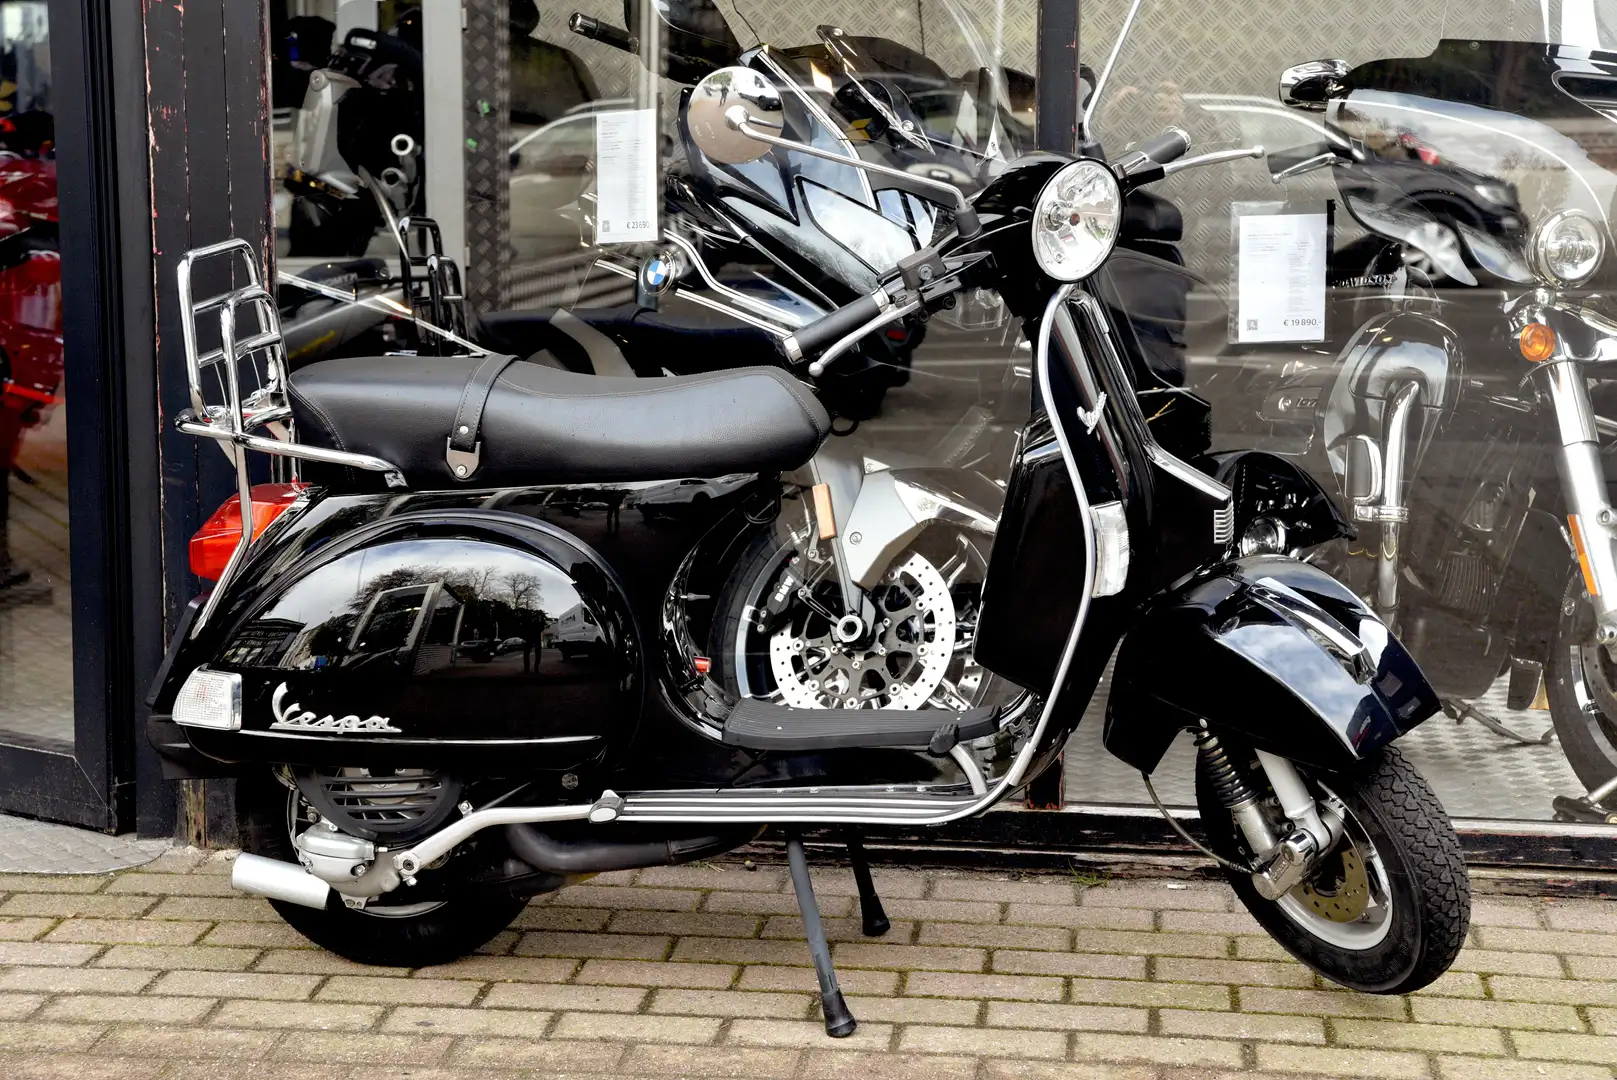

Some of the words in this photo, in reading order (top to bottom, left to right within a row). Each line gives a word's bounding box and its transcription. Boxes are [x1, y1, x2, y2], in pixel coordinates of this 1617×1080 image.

[1283, 319, 1289, 327] €
[774, 575, 795, 603] BMW
[269, 681, 402, 735] Vespa
